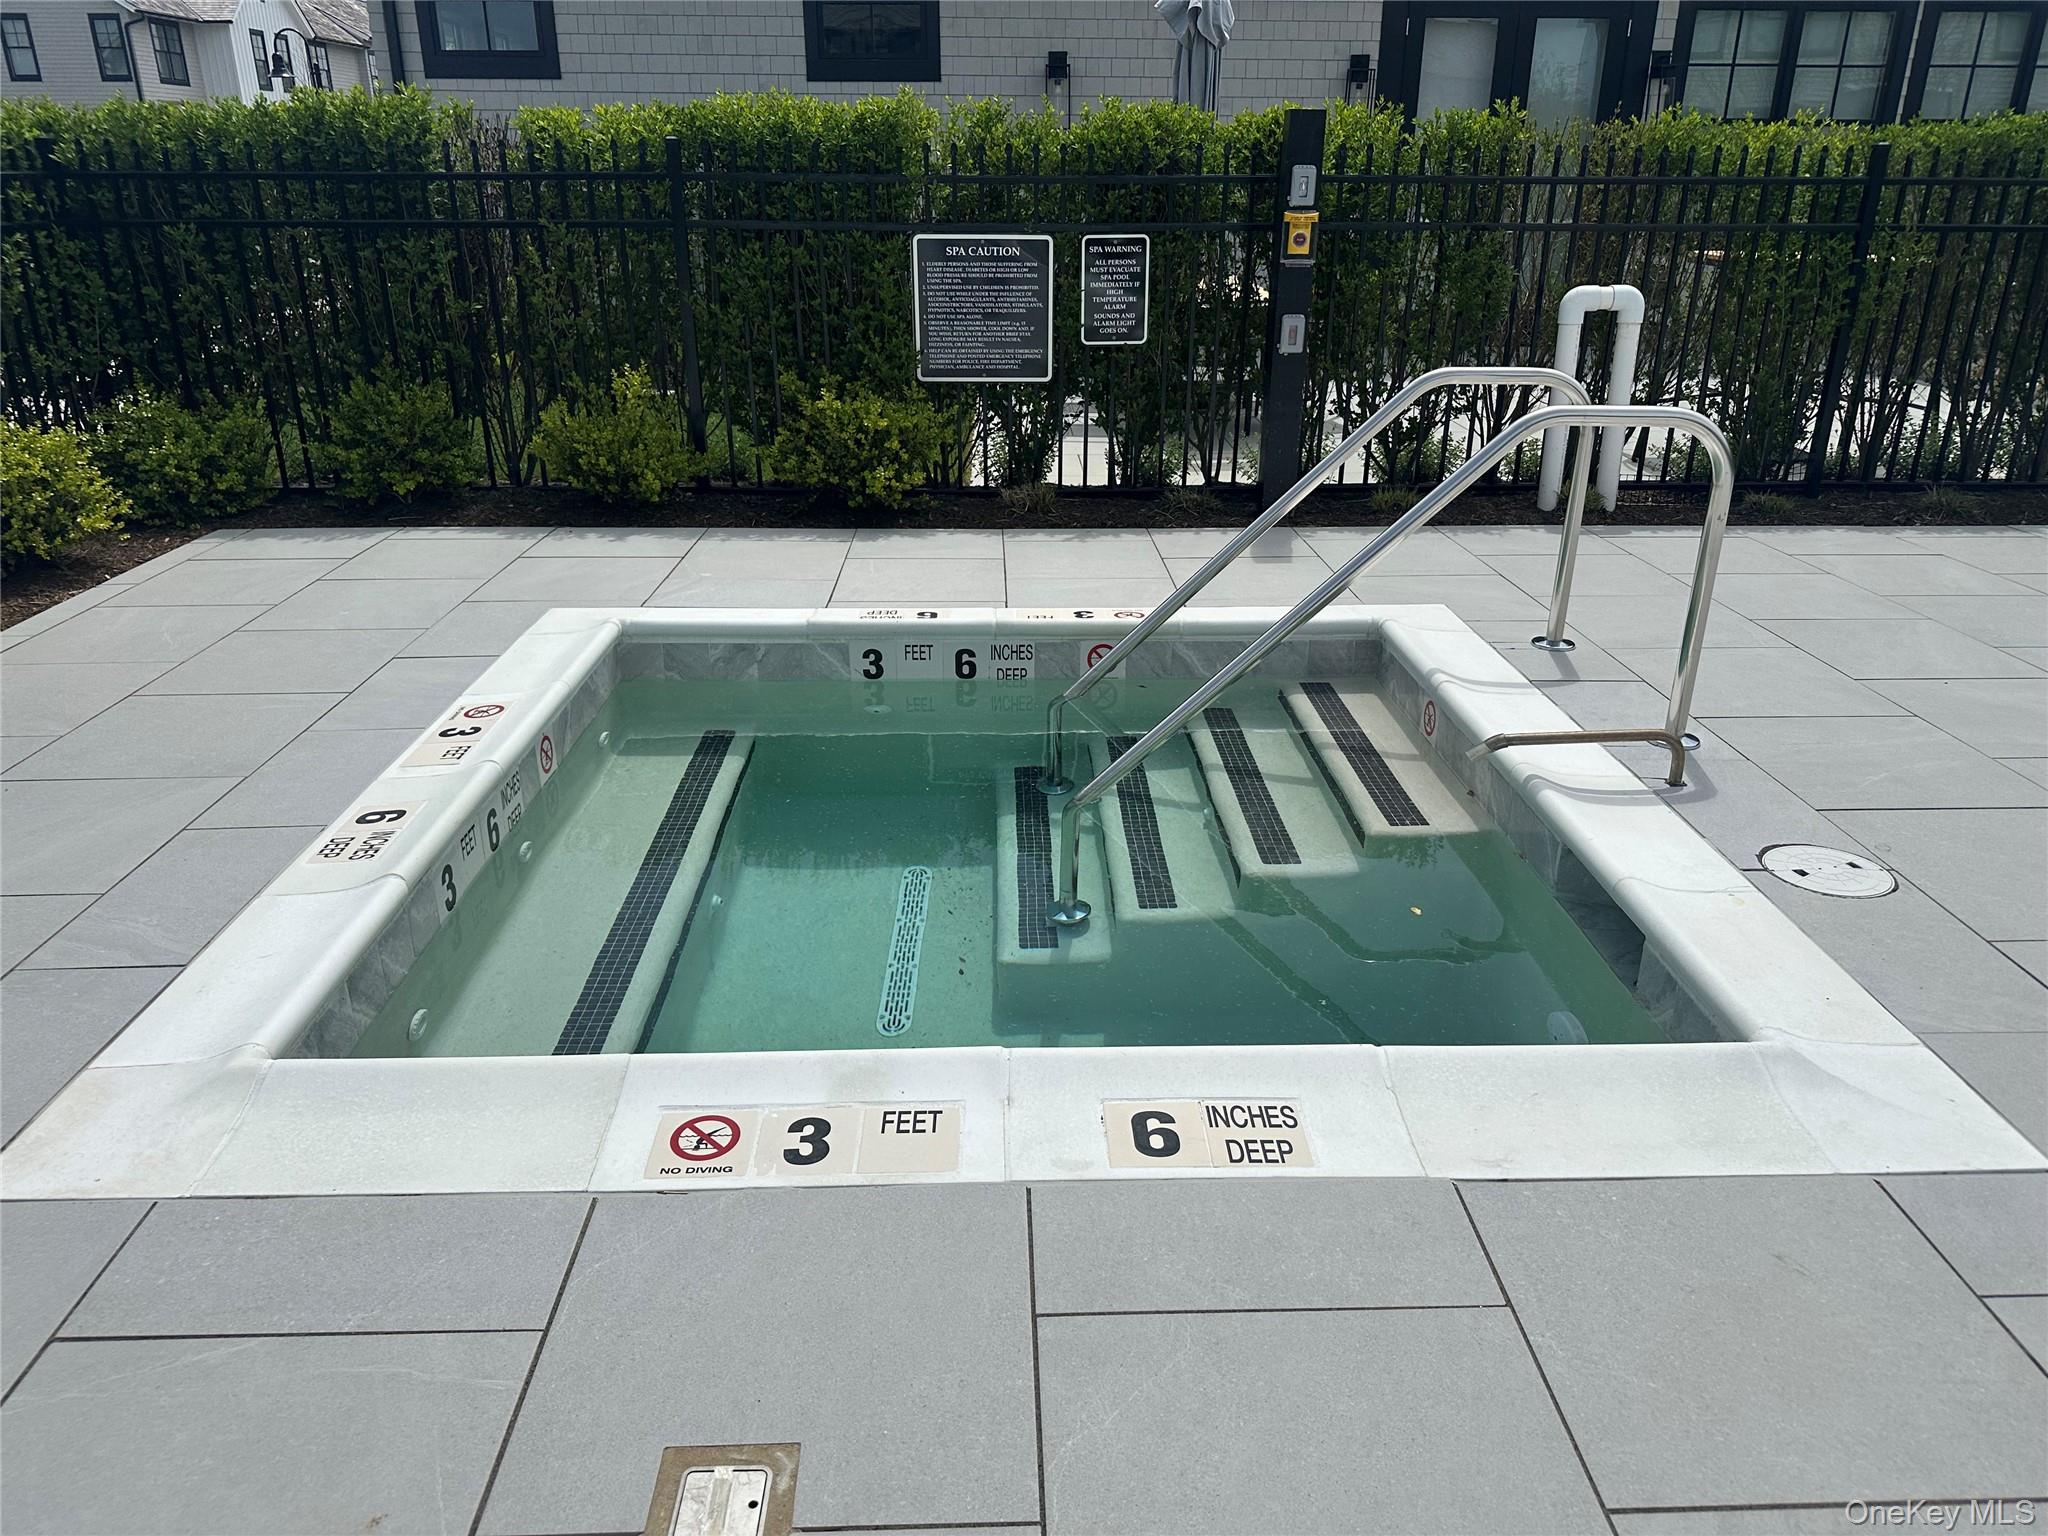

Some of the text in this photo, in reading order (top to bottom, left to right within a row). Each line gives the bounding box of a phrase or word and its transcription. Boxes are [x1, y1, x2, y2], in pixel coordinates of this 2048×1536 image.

[946, 246, 1020, 256] SPA CAUTION
[862, 644, 1034, 680] 3 FEET 6 INCHES
[996, 668, 1028, 680] DEEP
[439, 726, 482, 737] 3
[440, 746, 472, 760] FEET
[508, 803, 522, 832] DEEP
[348, 809, 407, 860] 6 INCHES
[441, 770, 520, 912] 3 FEET 6 INCHES
[316, 836, 356, 858] DEEP
[783, 1105, 1298, 1166] 3 FEET 6 INCHES
[1225, 1139, 1293, 1164] DEEP
[660, 1166, 733, 1175] NO DIVING
